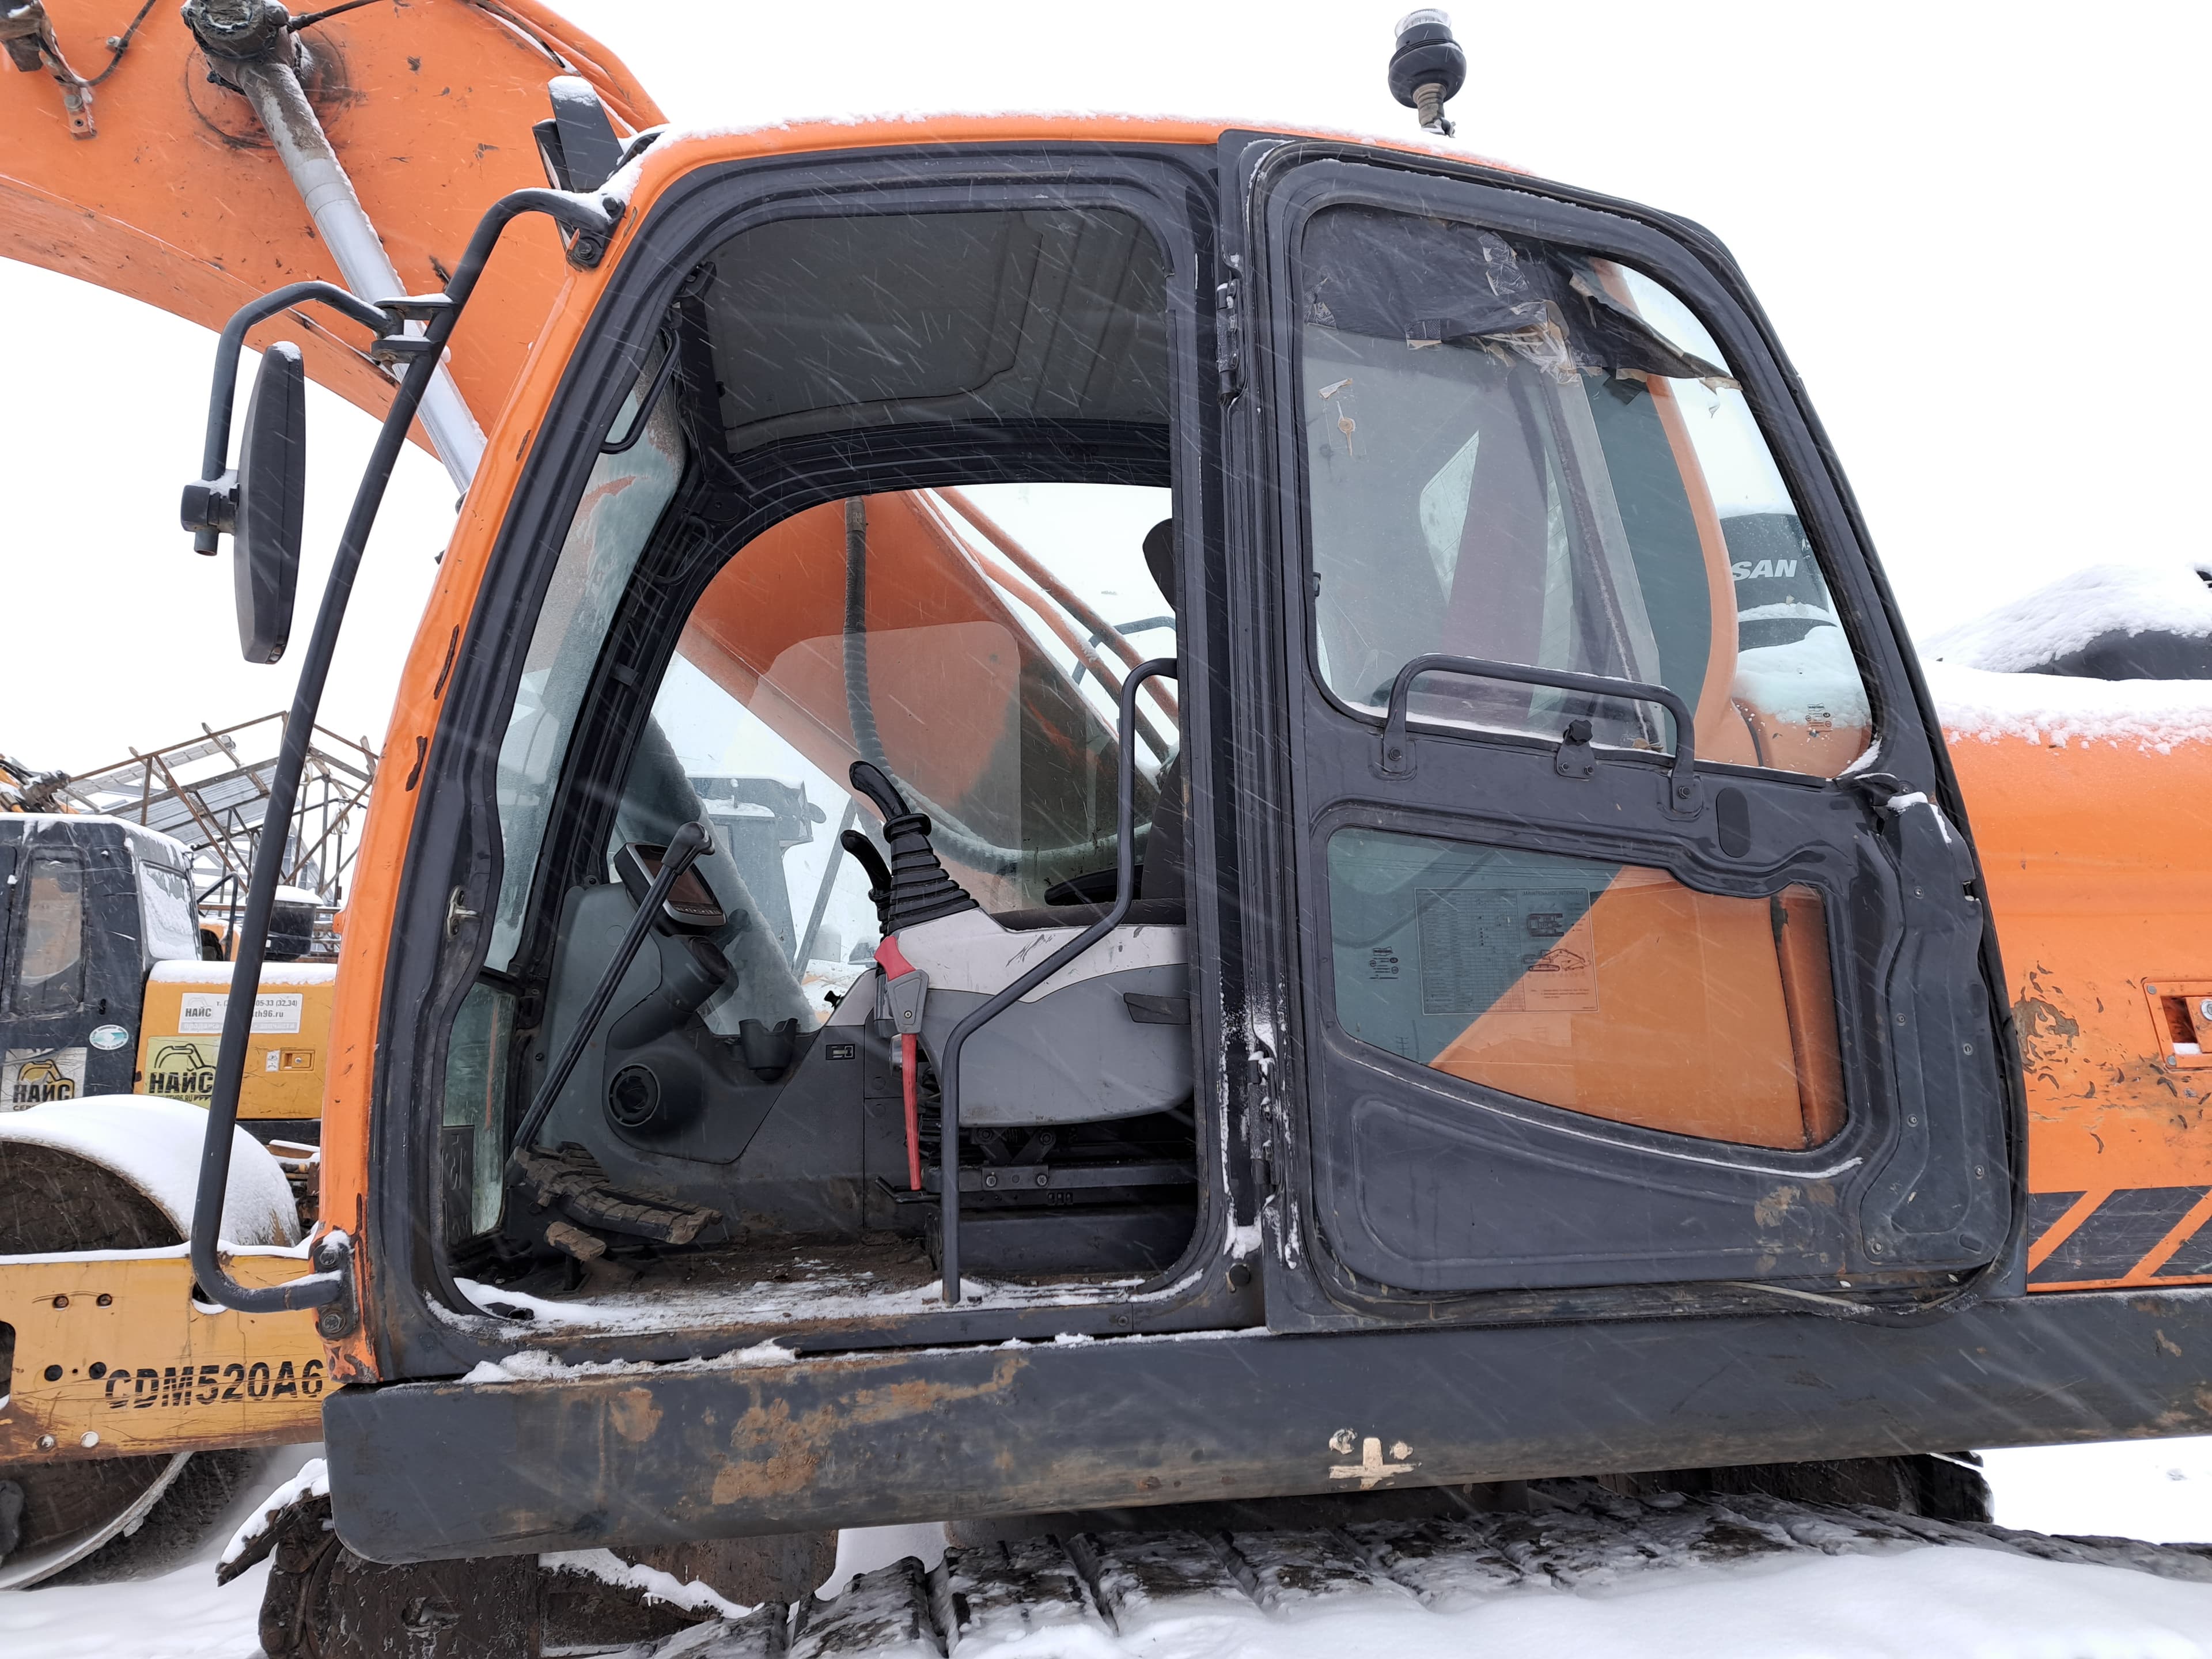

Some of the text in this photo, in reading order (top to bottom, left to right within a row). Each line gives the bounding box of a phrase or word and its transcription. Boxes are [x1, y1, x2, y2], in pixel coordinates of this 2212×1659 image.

[1731, 559, 1797, 581] SAN
[185, 1006, 212, 1017] НАЙС
[253, 1010, 284, 1018] th96.ru
[149, 1067, 213, 1093] НАЙС
[13, 1081, 70, 1103] НАЙС
[105, 1358, 323, 1409] CDM520A6
